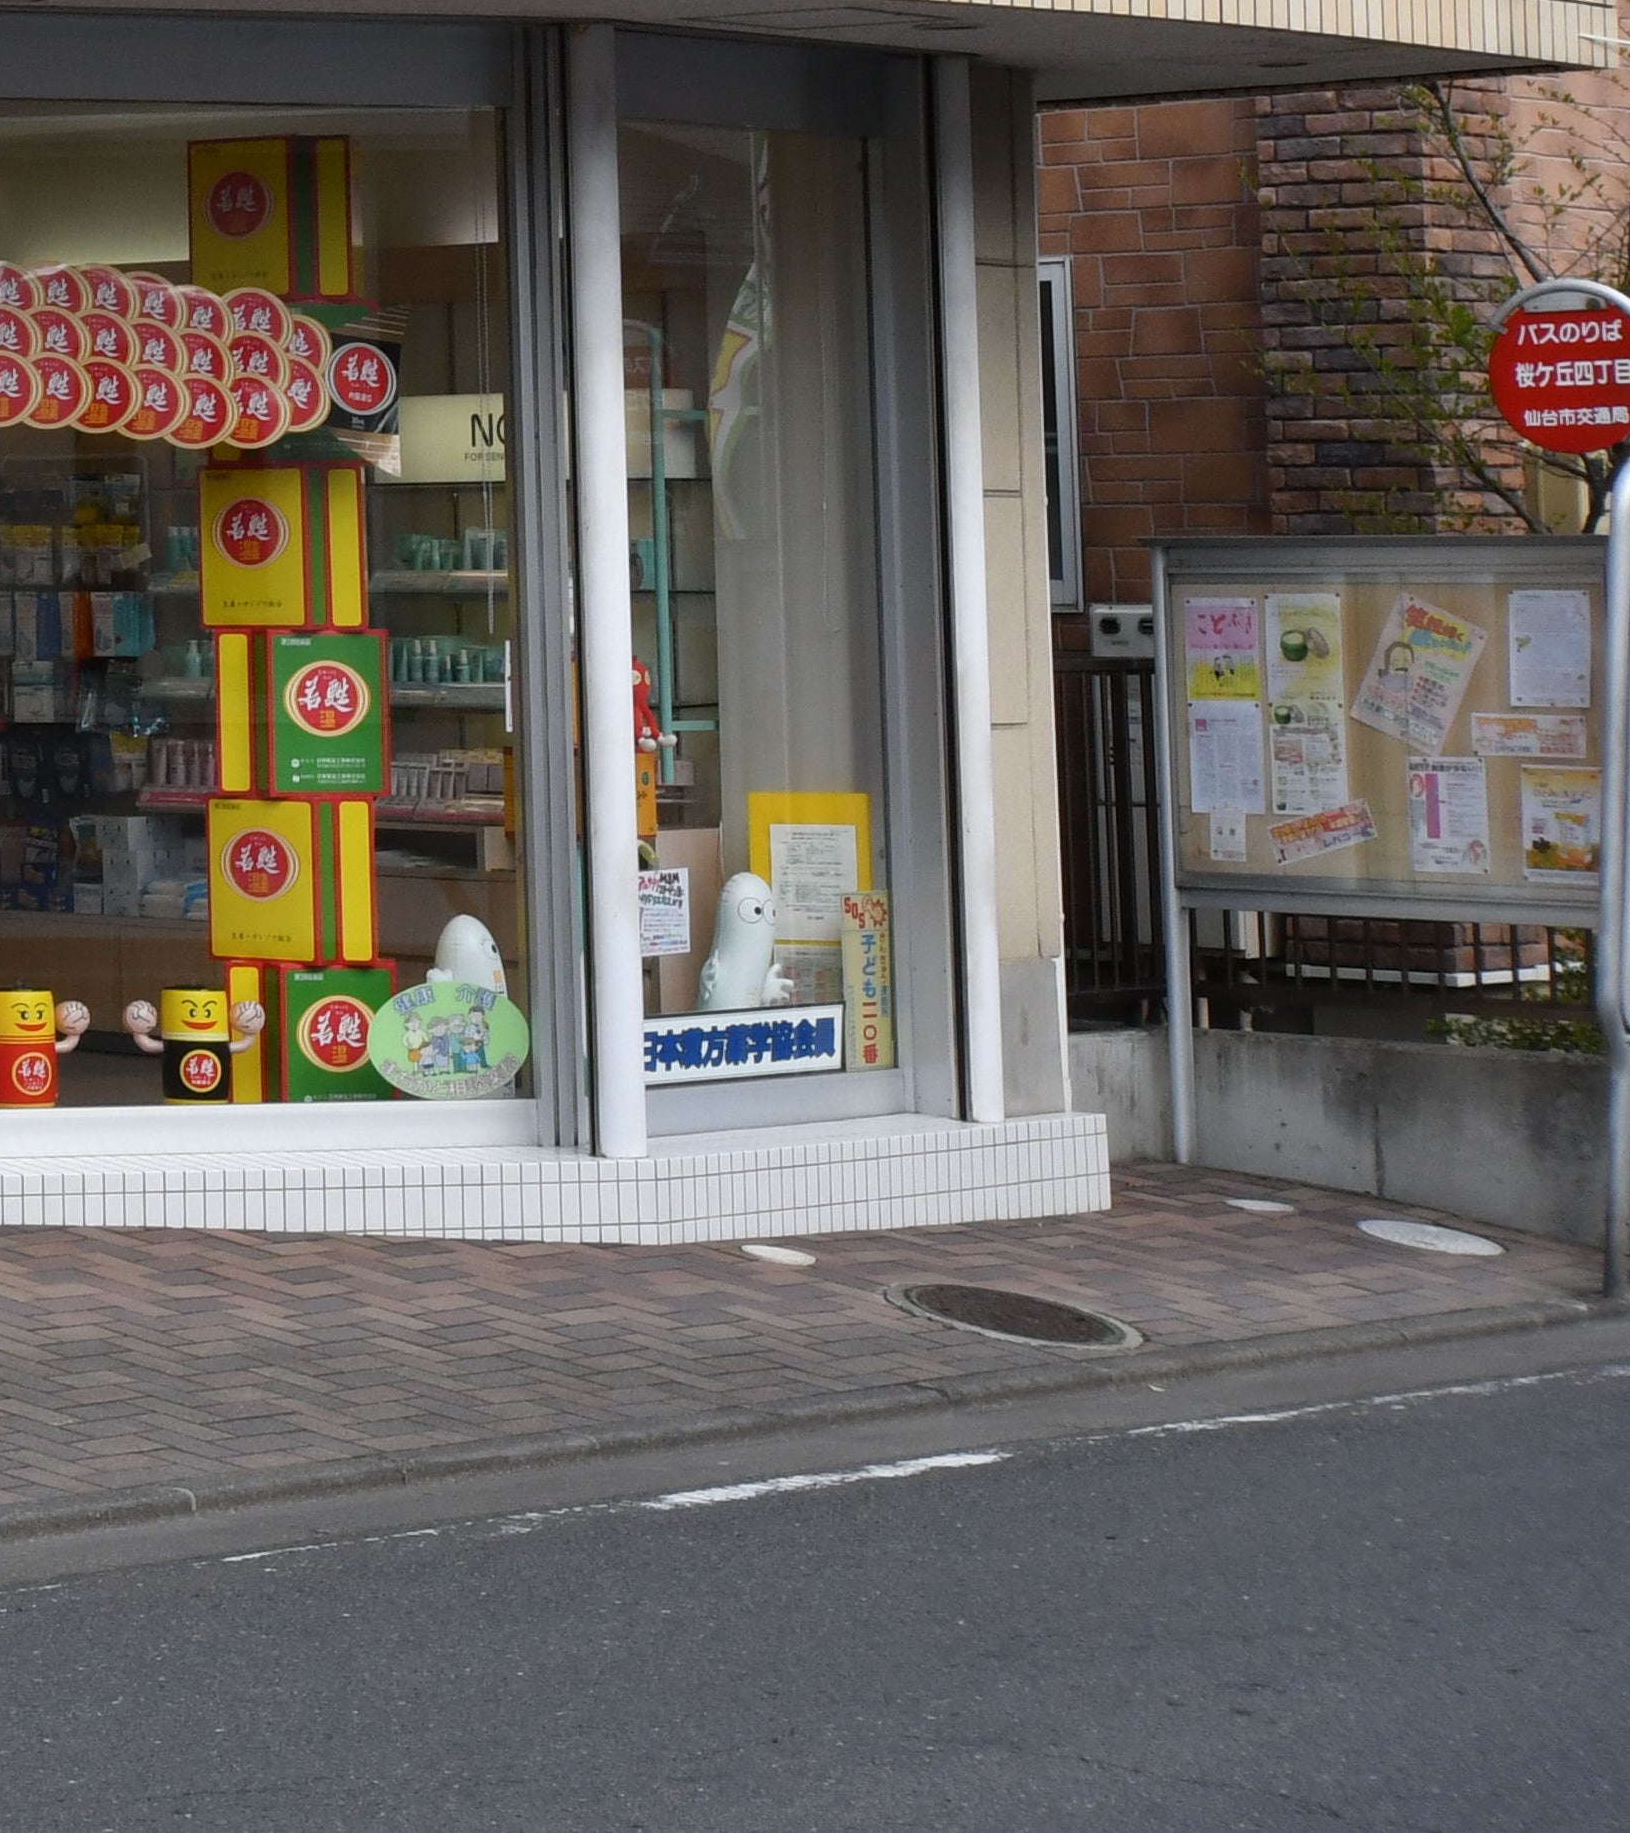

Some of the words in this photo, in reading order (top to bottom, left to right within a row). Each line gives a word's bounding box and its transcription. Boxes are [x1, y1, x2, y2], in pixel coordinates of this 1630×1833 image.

[1517, 318, 1623, 345] バスのりば
[1524, 406, 1629, 427] 仙台市交通局
[844, 897, 865, 929] SOS
